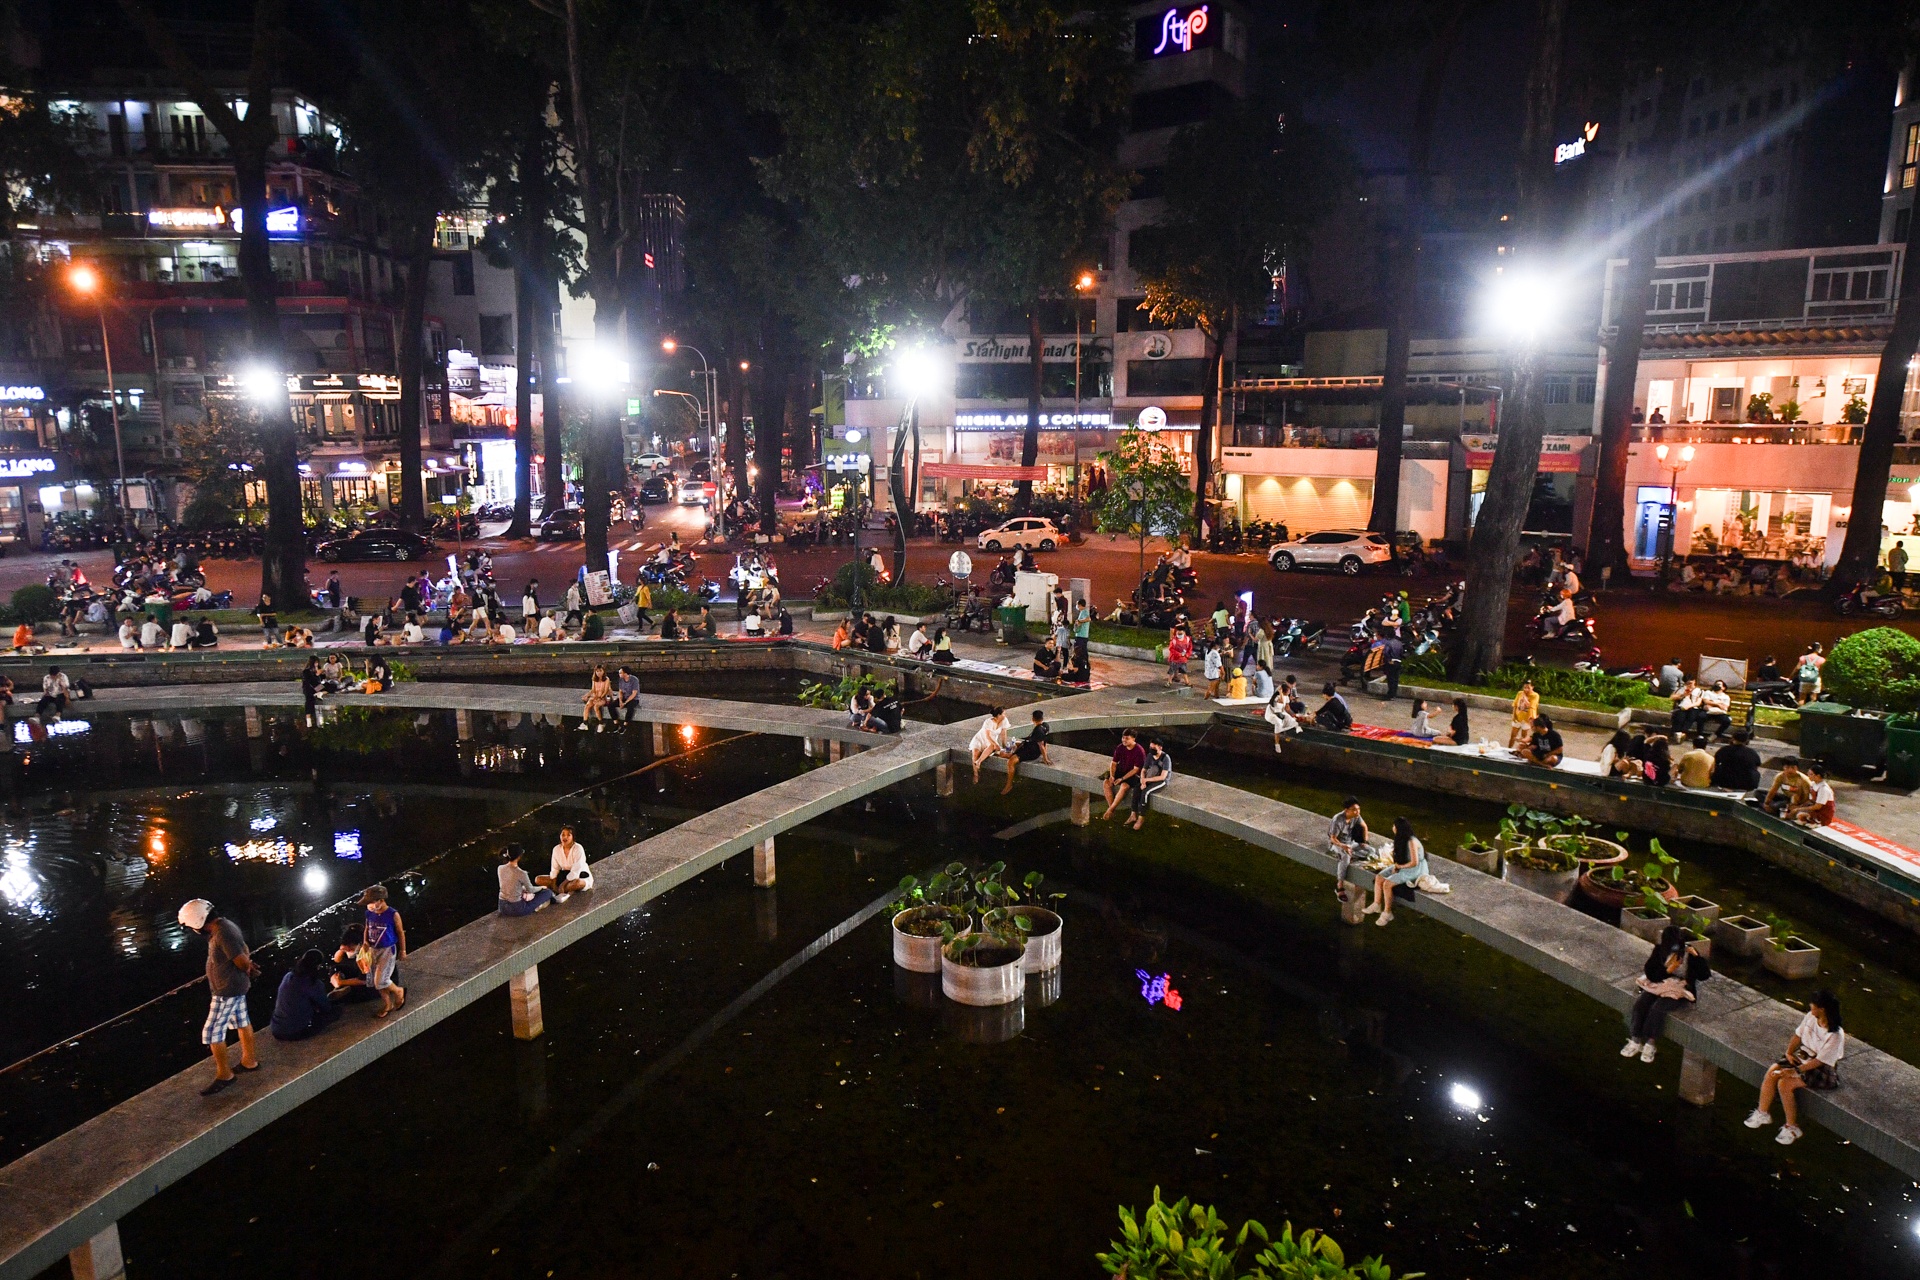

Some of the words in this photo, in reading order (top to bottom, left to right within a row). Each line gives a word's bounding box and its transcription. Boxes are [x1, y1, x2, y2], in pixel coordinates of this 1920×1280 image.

[963, 341, 1024, 360] Starlight
[956, 414, 1049, 426] HIGHLANS
[10, 459, 55, 472] LONG
